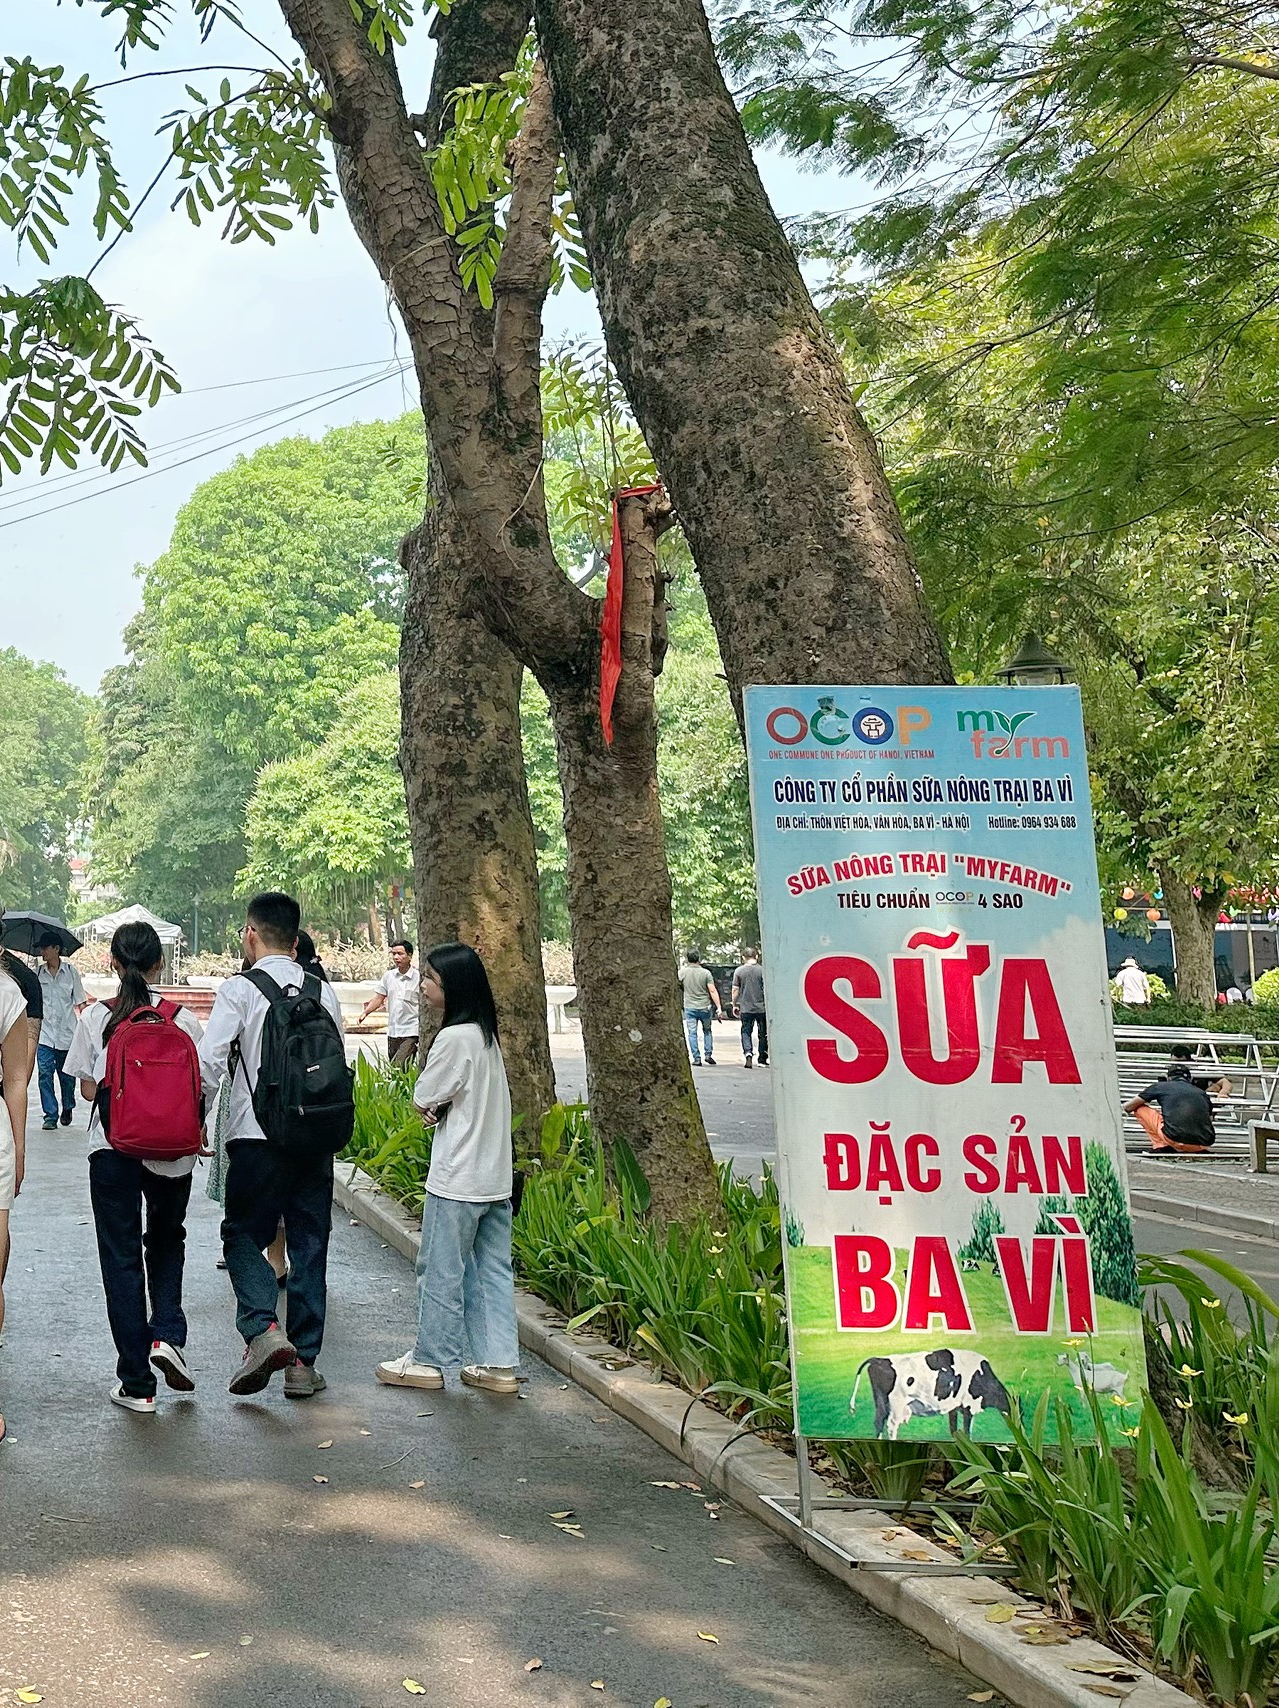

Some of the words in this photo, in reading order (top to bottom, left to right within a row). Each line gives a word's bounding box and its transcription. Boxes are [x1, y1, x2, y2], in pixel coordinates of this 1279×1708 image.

[766, 706, 932, 746] OCOP
[957, 710, 1036, 745] my
[971, 730, 1069, 759] farm
[769, 750, 783, 760] ONE
[785, 750, 819, 760] COMMUNE
[821, 750, 834, 760] ONE
[837, 750, 866, 760] PRODUCT
[869, 750, 878, 760] OF
[905, 750, 935, 760] VIETNAM
[774, 776, 816, 803] CÔNG
[820, 780, 836, 803] TY
[842, 772, 862, 803] CỔ
[867, 773, 908, 803] PHẦN
[913, 776, 944, 802] SỮA
[947, 776, 991, 802] NÔNG
[994, 780, 1029, 807] TRẠI
[1033, 780, 1054, 802] BA
[1058, 775, 1073, 802] VÌ
[777, 816, 791, 832] ĐỊA
[811, 814, 832, 829] THÔN
[834, 813, 850, 832] VIỆT
[892, 813, 911, 830] HÒA,
[914, 816, 926, 829] BA
[926, 814, 934, 829] VÌ
[942, 814, 953, 829] HÀ
[956, 814, 970, 832] NỘI
[989, 816, 1019, 829] Hotline:
[1022, 816, 1041, 829] 0964
[1044, 816, 1059, 829] 934
[1061, 816, 1076, 829] 688
[787, 866, 831, 896] SỮA
[834, 855, 894, 881] NÔNG
[899, 853, 946, 877] TRẠI
[955, 855, 1072, 897] "MYFARM"
[837, 890, 871, 909] TIÊU
[876, 887, 930, 909] CHUẨN
[936, 891, 974, 901] OCOP
[978, 893, 987, 909] 4
[993, 893, 1023, 909] SAO
[804, 931, 1082, 1085] SỮA
[823, 1120, 941, 1205] ĐẶC
[963, 1115, 1087, 1196] SẢN
[834, 1235, 970, 1331] BA
[995, 1216, 1094, 1333] VÌ
